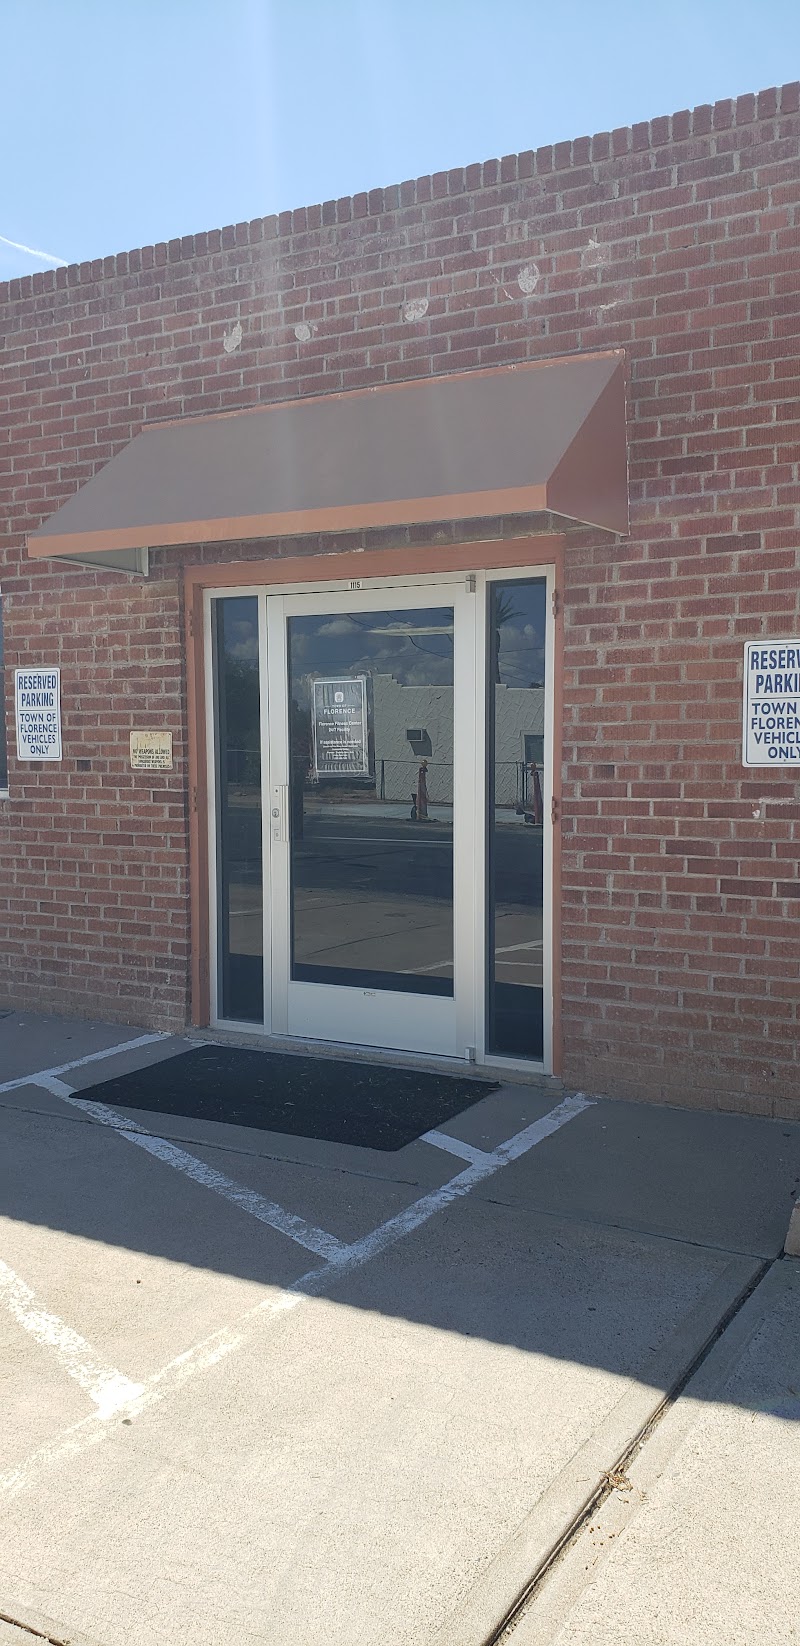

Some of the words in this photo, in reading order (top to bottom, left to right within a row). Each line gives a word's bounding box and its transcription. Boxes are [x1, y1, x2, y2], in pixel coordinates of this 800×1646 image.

[350, 581, 361, 589] 1115
[18, 675, 57, 690] RESERVED
[755, 673, 800, 694] PARKI
[21, 692, 54, 707] PARKING
[751, 702, 797, 715] TOWN
[20, 713, 44, 723] TOWN
[46, 713, 56, 722] OF
[20, 724, 57, 733] FLORENCE
[22, 734, 56, 744] VEHICLES
[30, 745, 50, 754] ONLY
